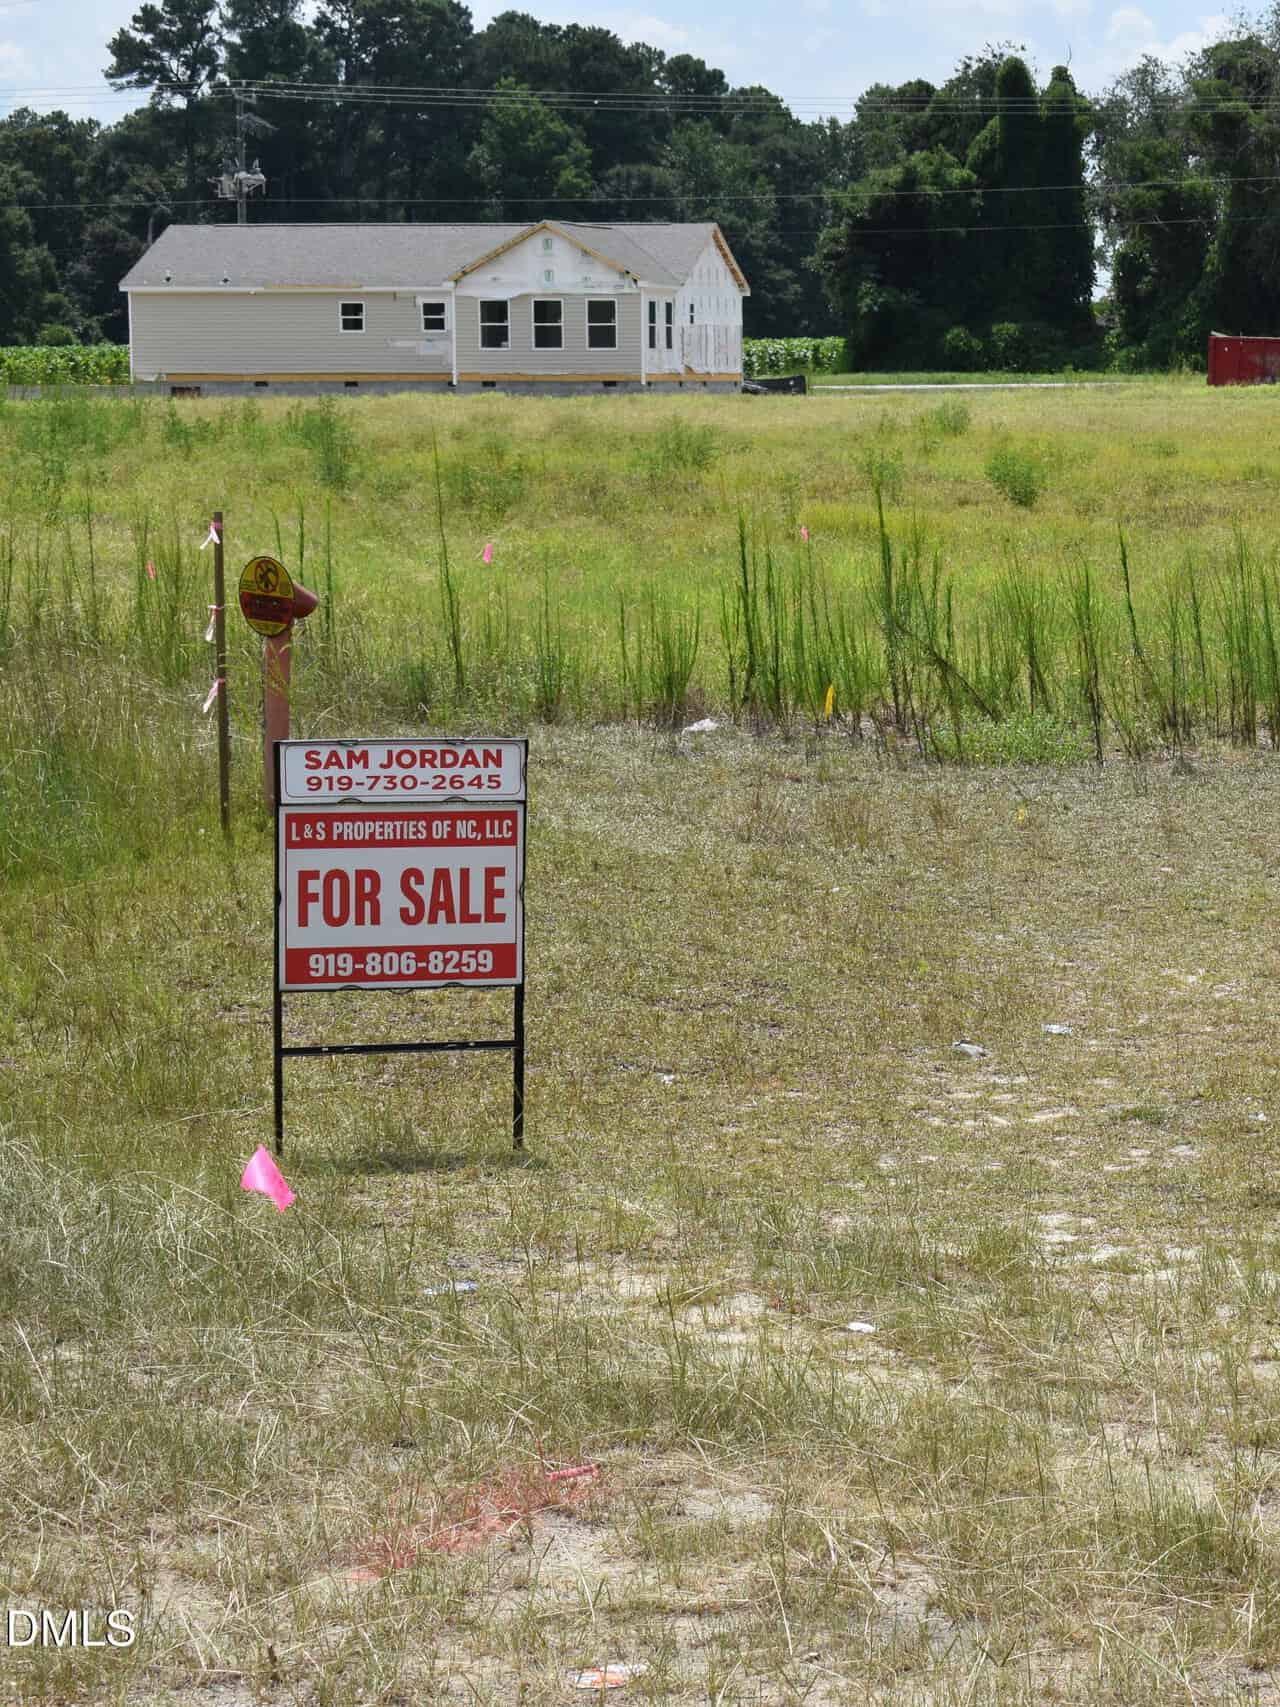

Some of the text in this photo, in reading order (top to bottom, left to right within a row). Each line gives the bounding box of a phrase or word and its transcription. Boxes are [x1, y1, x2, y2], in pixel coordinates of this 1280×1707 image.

[304, 749, 503, 770] SAM JORDAN
[306, 774, 502, 791] 919-730-2645
[291, 819, 513, 841] L & S PROPERTIES OF NC, LLC
[297, 867, 507, 927] FOR SALE
[309, 950, 494, 977] 919-806-8259
